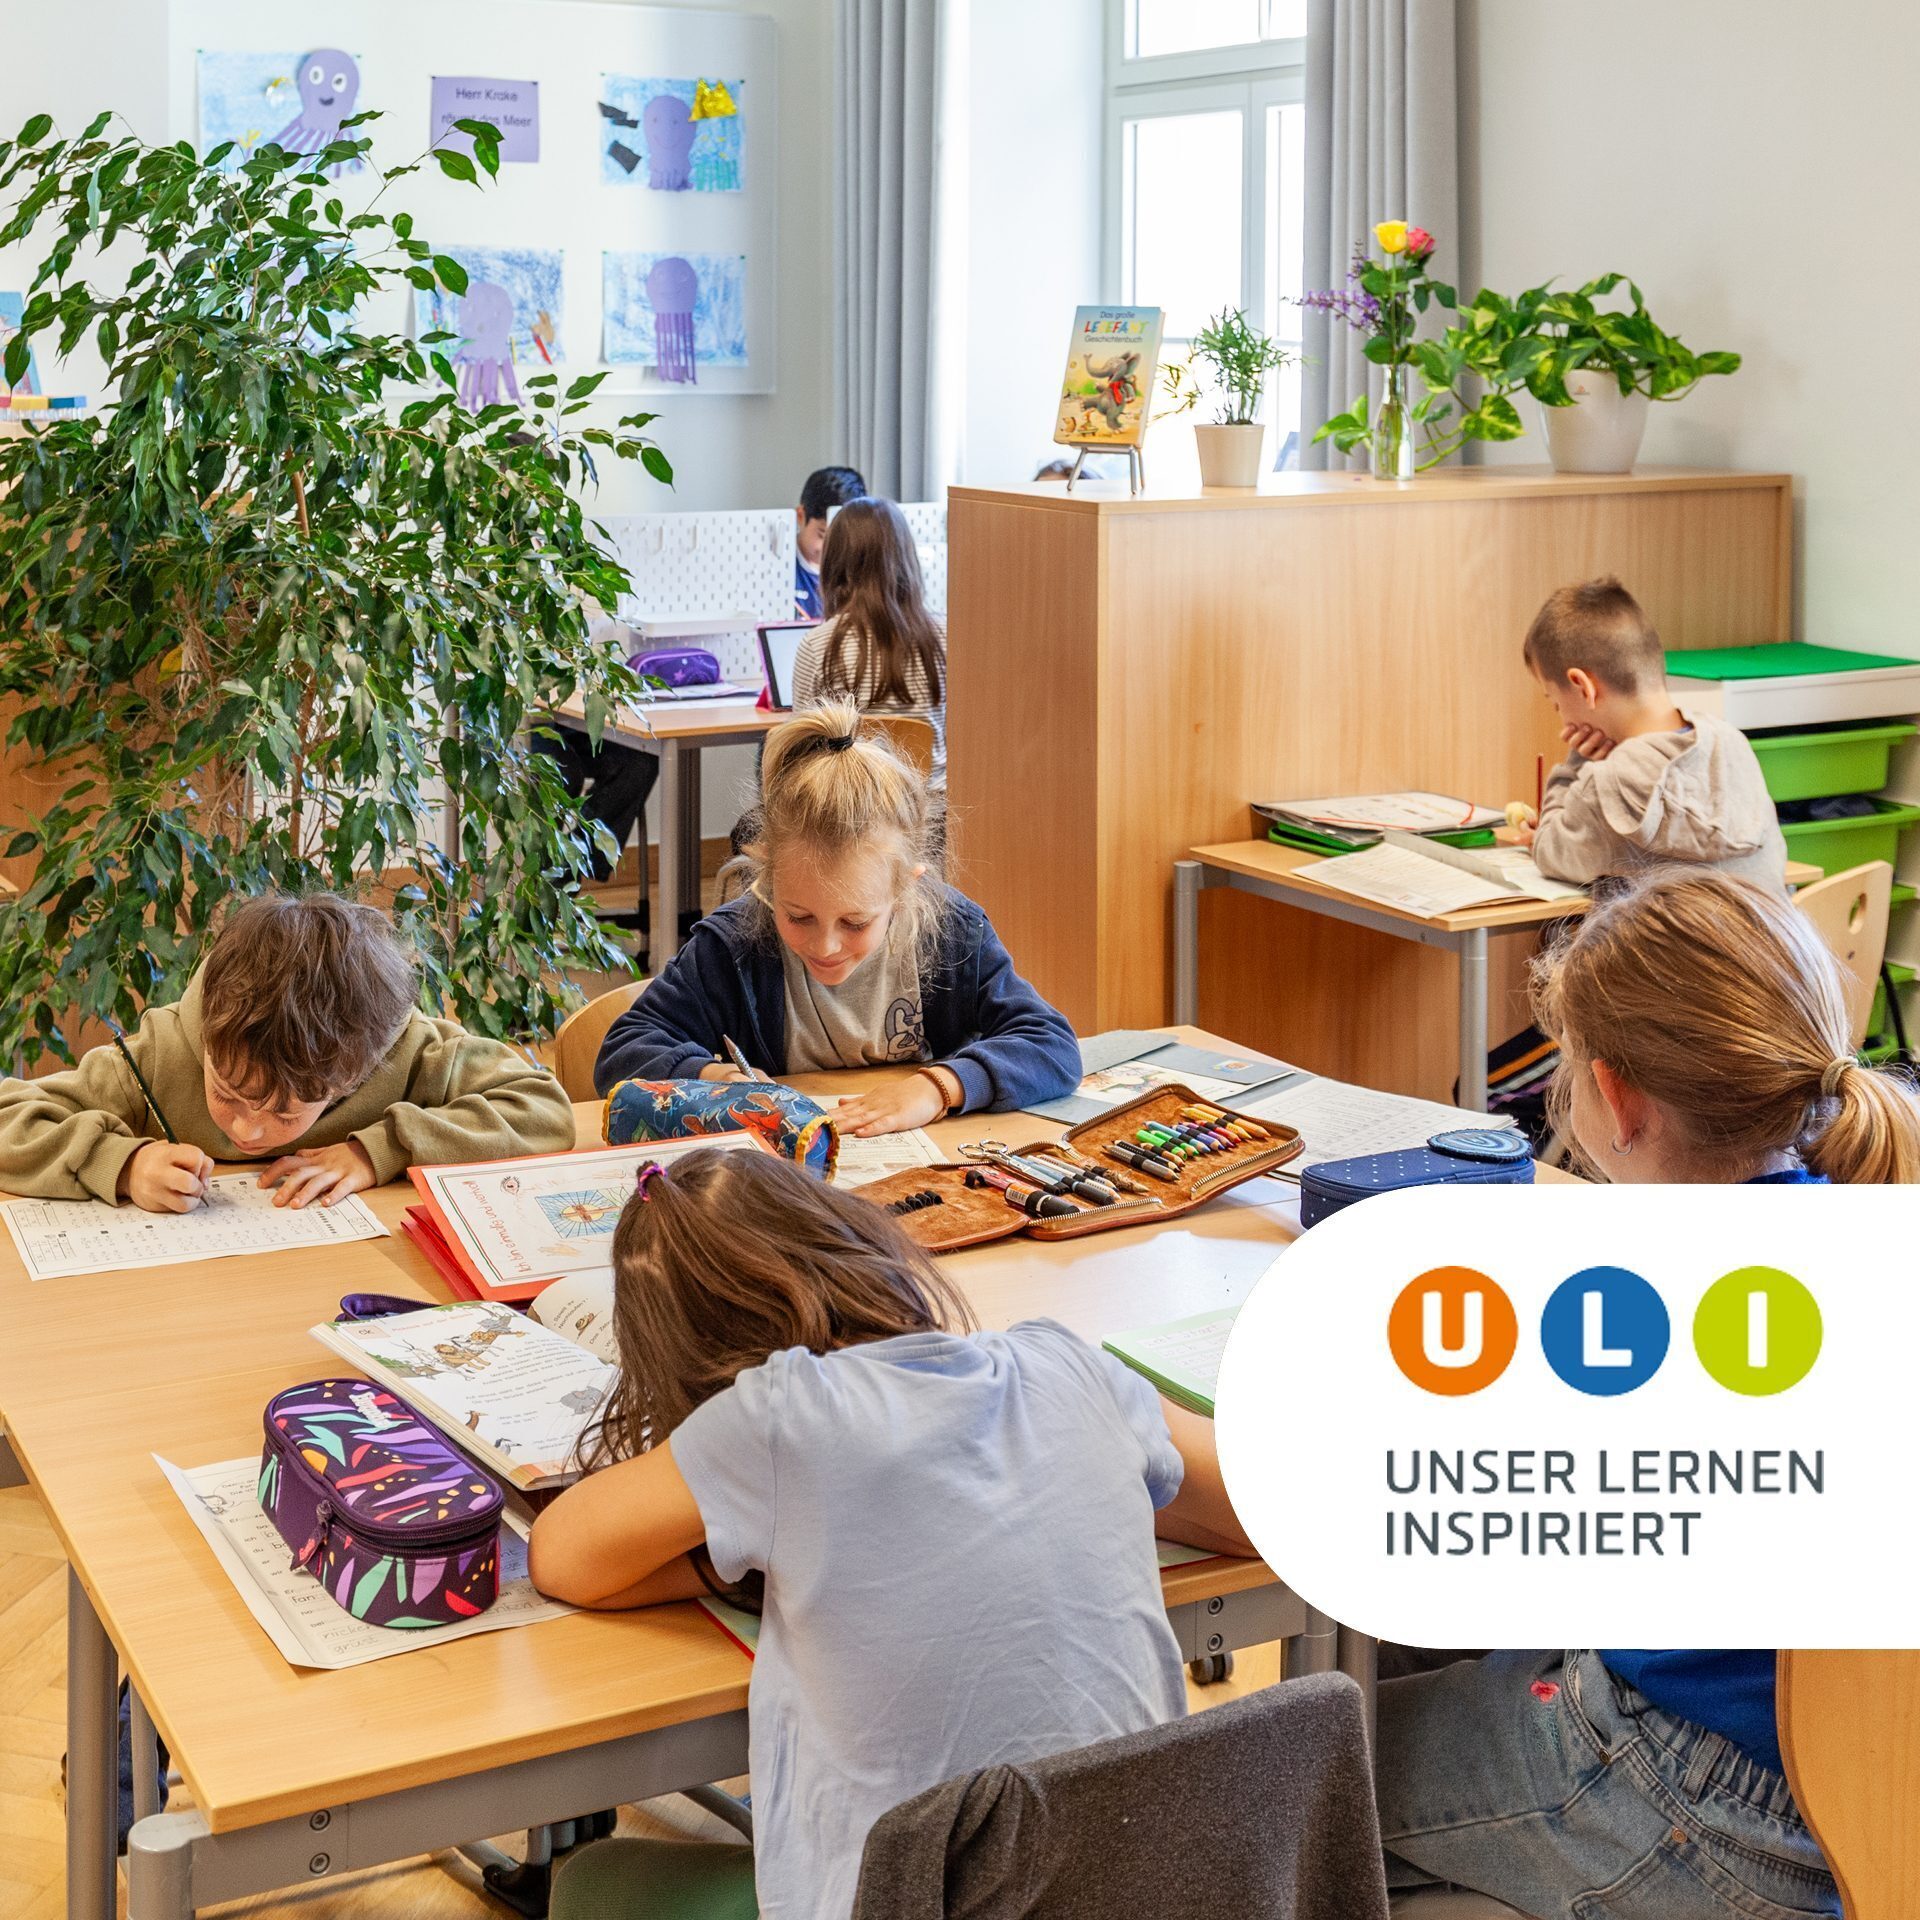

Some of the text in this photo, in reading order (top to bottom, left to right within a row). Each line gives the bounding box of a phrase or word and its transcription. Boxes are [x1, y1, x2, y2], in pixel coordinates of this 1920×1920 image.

[456, 88, 481, 99] Herr
[503, 115, 531, 126] Meer
[1084, 334, 1143, 343] Geschichtenbuch
